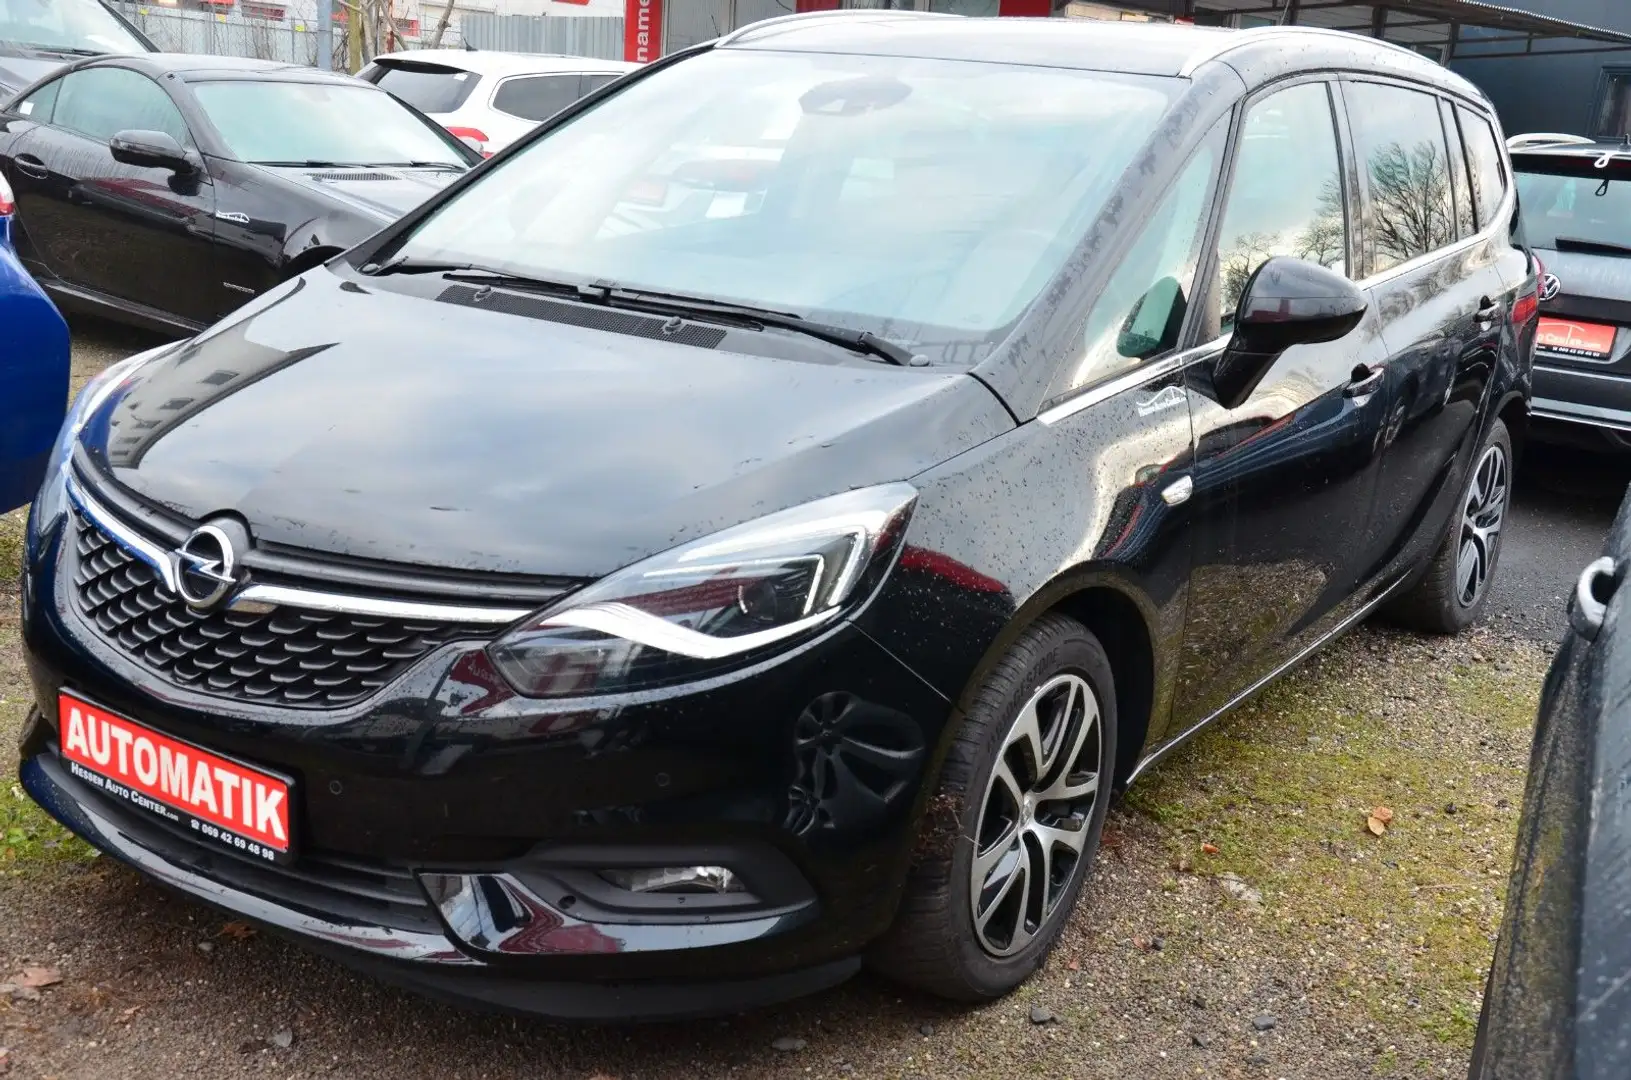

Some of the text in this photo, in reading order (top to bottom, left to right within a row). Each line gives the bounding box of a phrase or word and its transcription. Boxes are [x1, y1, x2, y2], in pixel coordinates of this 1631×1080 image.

[66, 707, 286, 841] AUTOMATIK
[201, 823, 275, 861] 069 42 69 48 98
